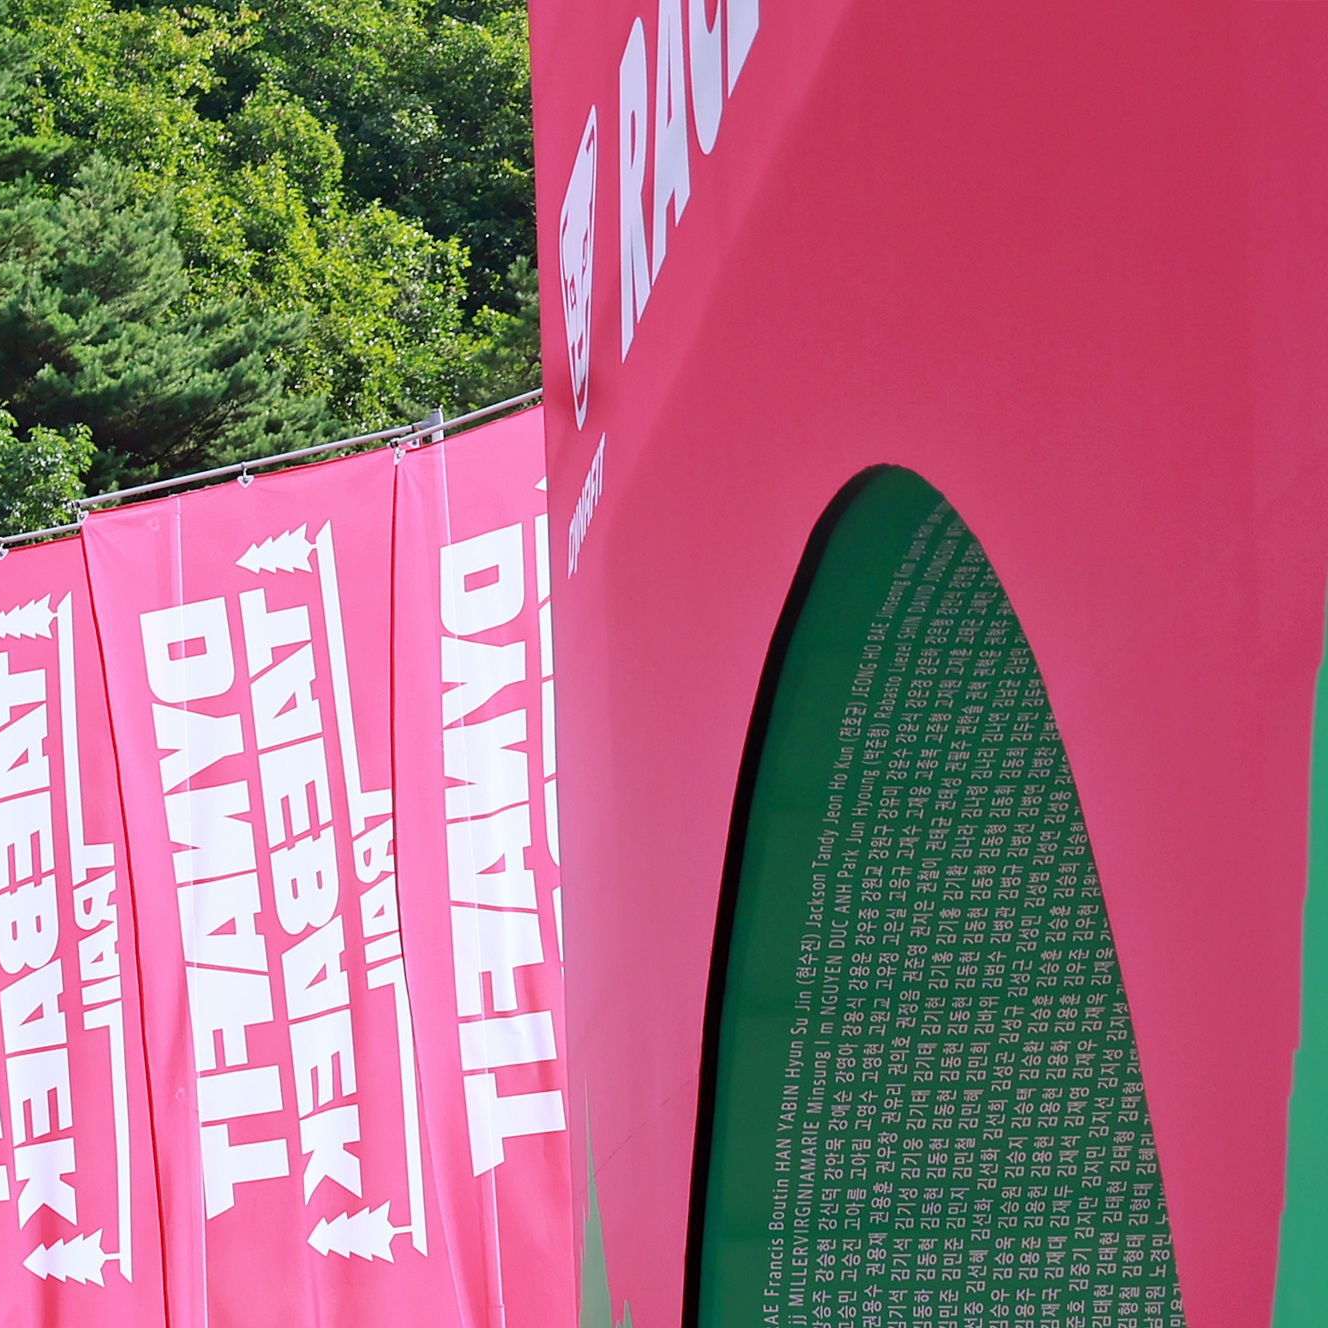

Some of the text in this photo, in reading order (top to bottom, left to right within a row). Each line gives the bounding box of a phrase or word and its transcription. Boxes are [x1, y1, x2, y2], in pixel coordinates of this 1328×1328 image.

[568, 431, 606, 579] DYNAFIT
[866, 622, 890, 641] BAE
[862, 644, 882, 659] HO
[887, 642, 912, 672] Liezel
[851, 663, 878, 698] JEONG
[873, 676, 902, 718] Rabasto
[832, 746, 854, 769] Kun
[861, 723, 890, 765] (박준형)
[828, 773, 848, 790] Ho
[885, 748, 913, 780] 강윤수
[822, 795, 843, 824] Jeon
[851, 769, 880, 816] Hyoung
[877, 785, 904, 819] 강유미
[811, 829, 839, 868] Tandy
[845, 821, 865, 844] Jun
[867, 824, 894, 860] 강원구
[896, 825, 922, 860] 고재수
[836, 849, 859, 878] Park
[805, 873, 826, 928] Jackson
[833, 884, 852, 914] ANH
[860, 865, 883, 902] 강원교
[888, 865, 912, 902] 고응규
[828, 919, 849, 948] DUC
[854, 908, 880, 946] 강우종
[882, 908, 907, 946] 고은실
[795, 933, 821, 985] (현수진)
[848, 952, 872, 991] 강용운
[875, 952, 900, 991] 고유정
[794, 991, 812, 1011] Jin
[819, 955, 843, 1015] NGUYEN
[790, 1018, 809, 1035] Su
[841, 997, 867, 1036] 강용식
[868, 997, 891, 1036] 고원교
[784, 1040, 804, 1078] Hyun
[834, 1043, 858, 1083] 강영아
[861, 1043, 884, 1083] 고영현
[805, 1051, 831, 1113] Minsung
[776, 1085, 799, 1131] YABIN
[828, 1090, 853, 1131] 강애순
[854, 1089, 878, 1131] 고영수
[774, 1138, 792, 1171] HAN
[849, 1138, 871, 1180] 고아림
[768, 1178, 789, 1230] Boutin
[788, 1121, 820, 1306] MILLERVIRGINIAMARIE
[817, 1188, 841, 1231] 강신덕
[844, 1187, 867, 1230] 고아름
[763, 1238, 784, 1296] Francis
[814, 1238, 836, 1282] 강승현
[840, 1238, 862, 1282] 고승진
[787, 1314, 807, 1326] jj
